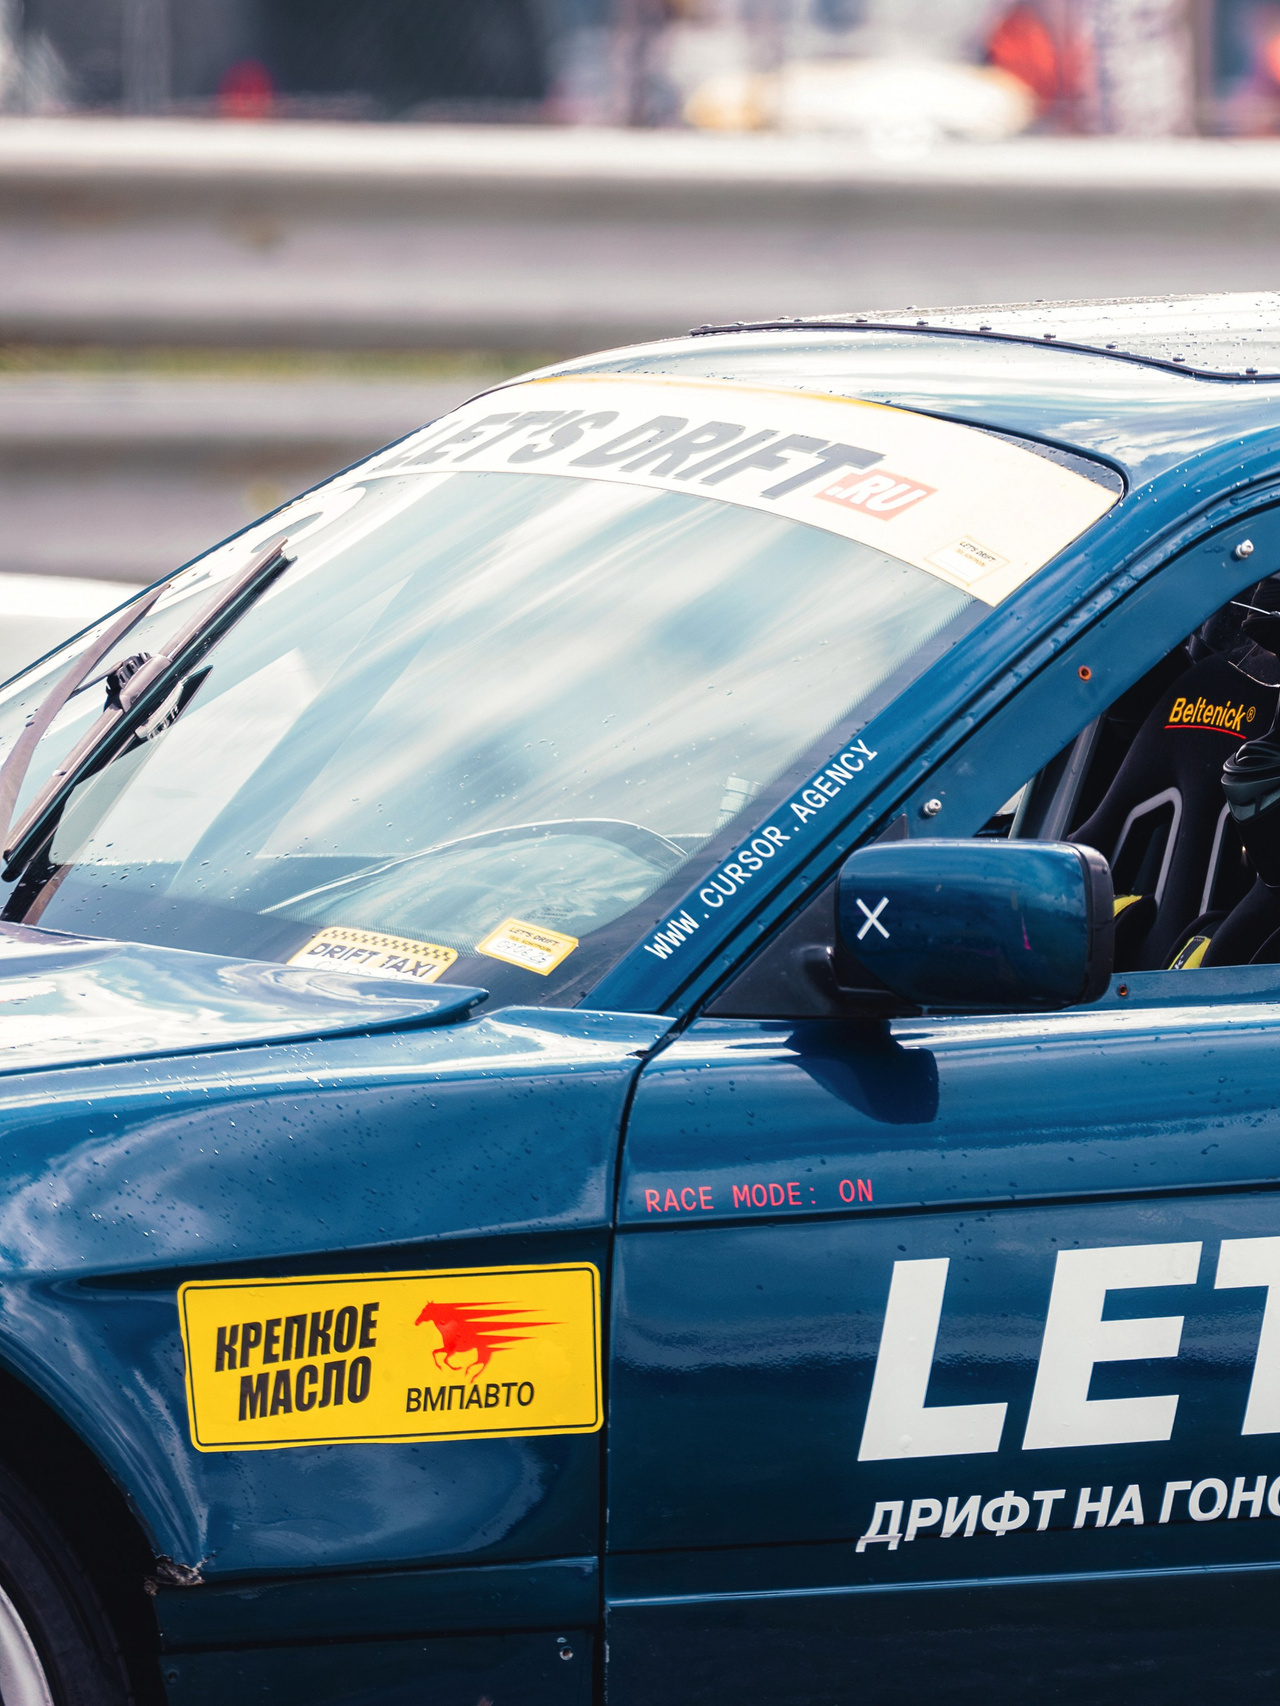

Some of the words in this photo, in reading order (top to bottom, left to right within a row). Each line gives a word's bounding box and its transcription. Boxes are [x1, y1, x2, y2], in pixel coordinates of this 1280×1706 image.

[371, 409, 620, 473] LET'S
[567, 415, 887, 501] DRIFT
[306, 942, 384, 965] DRIFT
[379, 954, 438, 978] TAXI
[645, 1185, 715, 1214] RACE
[732, 1181, 819, 1208] MODE:
[838, 1178, 875, 1203] ON
[214, 1301, 381, 1374] КРЕПКОЕ
[237, 1355, 373, 1423] МАСЛО
[404, 1380, 536, 1414] ВМПАВТО
[855, 1487, 1066, 1553] ДРИФТ
[1073, 1484, 1145, 1530] НА
